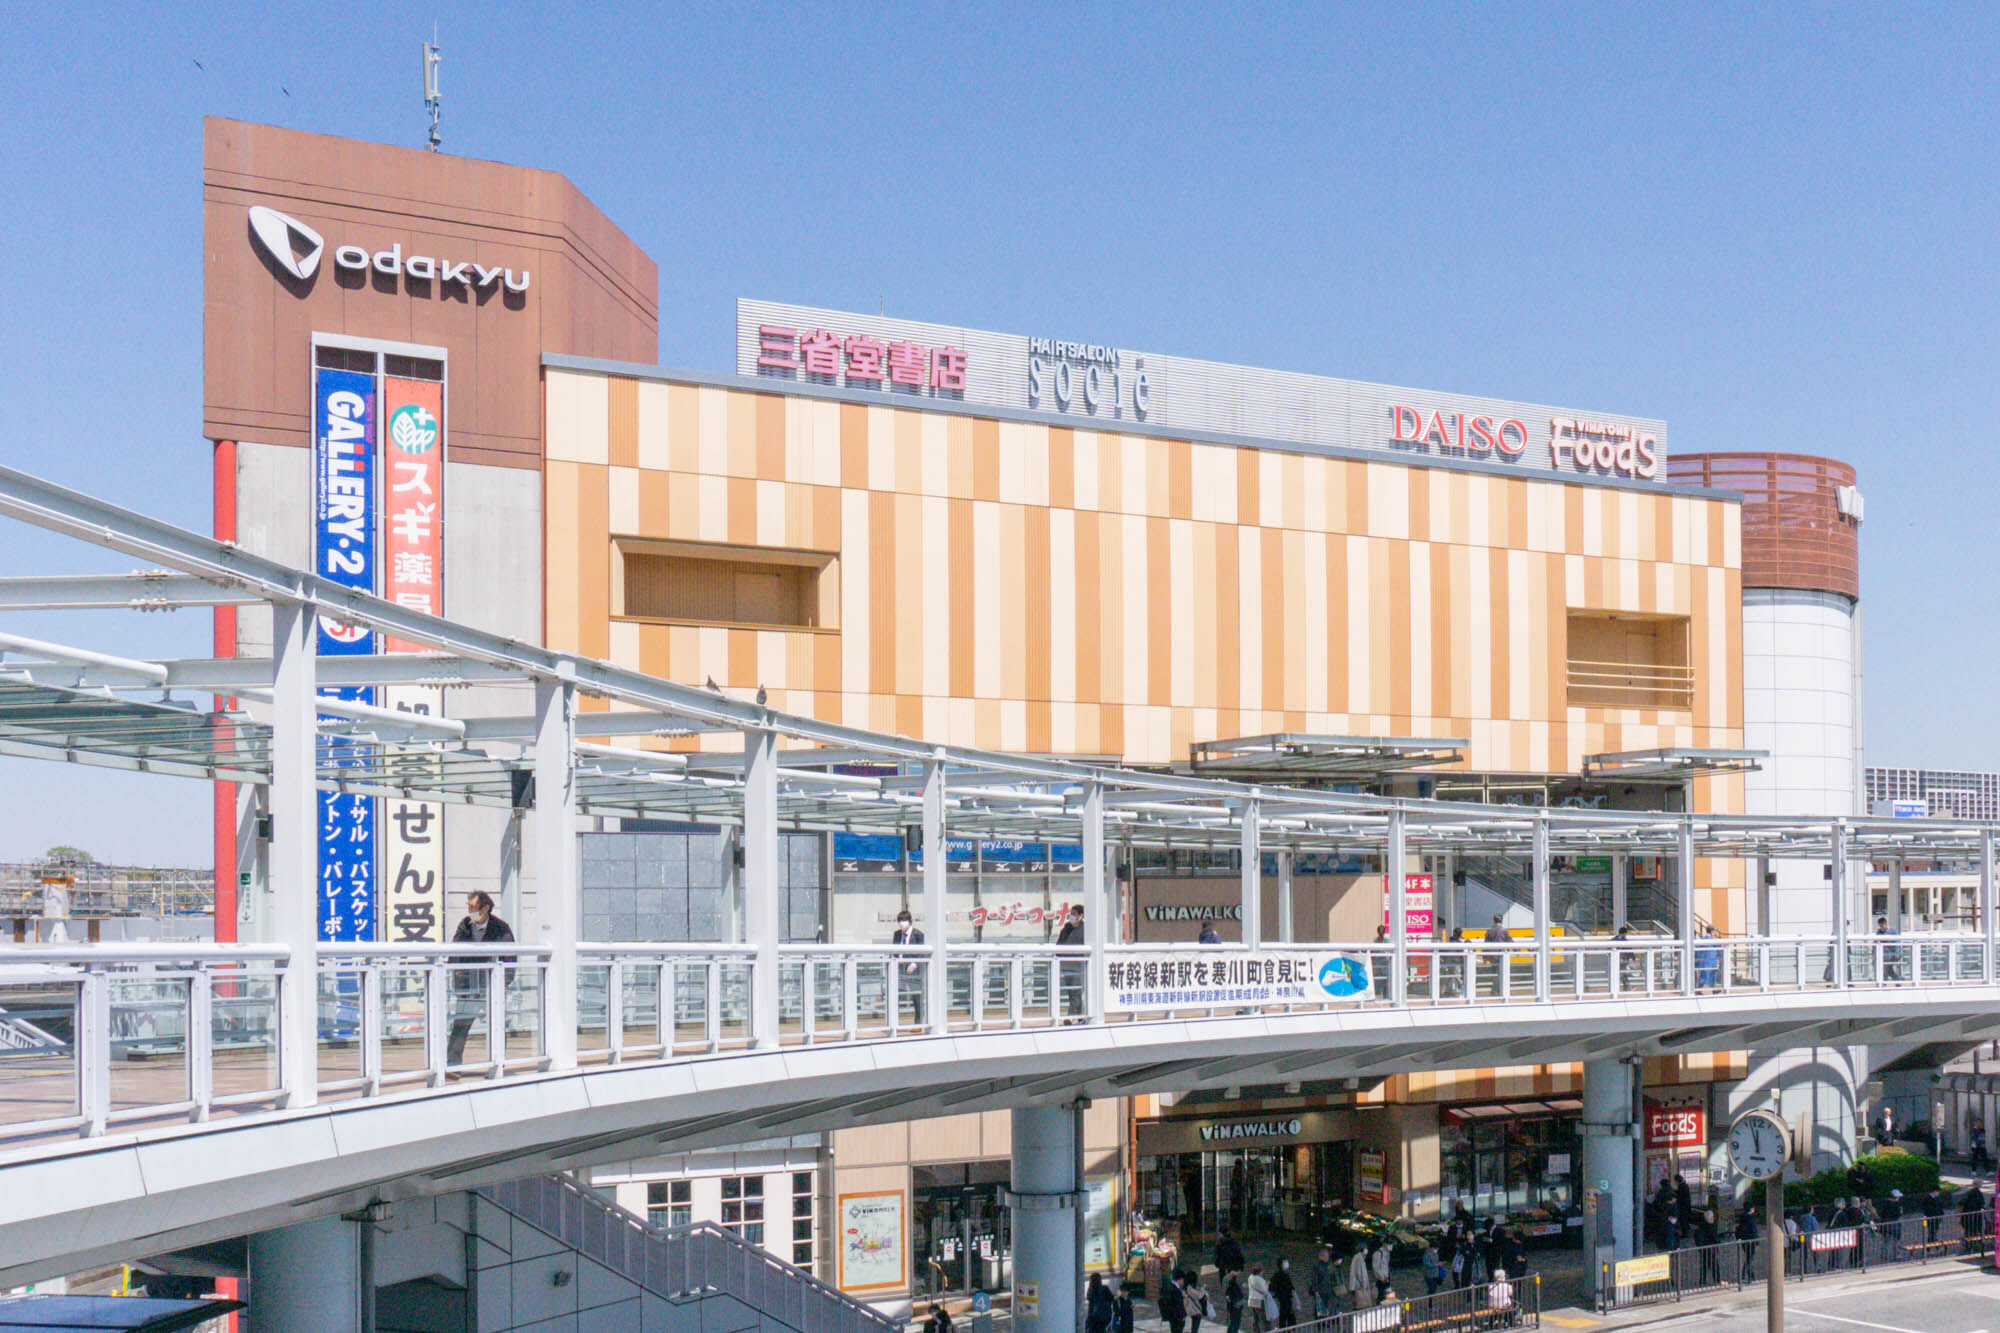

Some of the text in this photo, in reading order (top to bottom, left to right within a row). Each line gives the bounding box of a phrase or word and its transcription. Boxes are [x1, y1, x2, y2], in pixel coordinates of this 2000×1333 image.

[336, 244, 530, 291] odakyu
[758, 324, 969, 390] 三省堂書店
[1392, 404, 1529, 454] DAISO
[975, 1295, 987, 1309] 4
